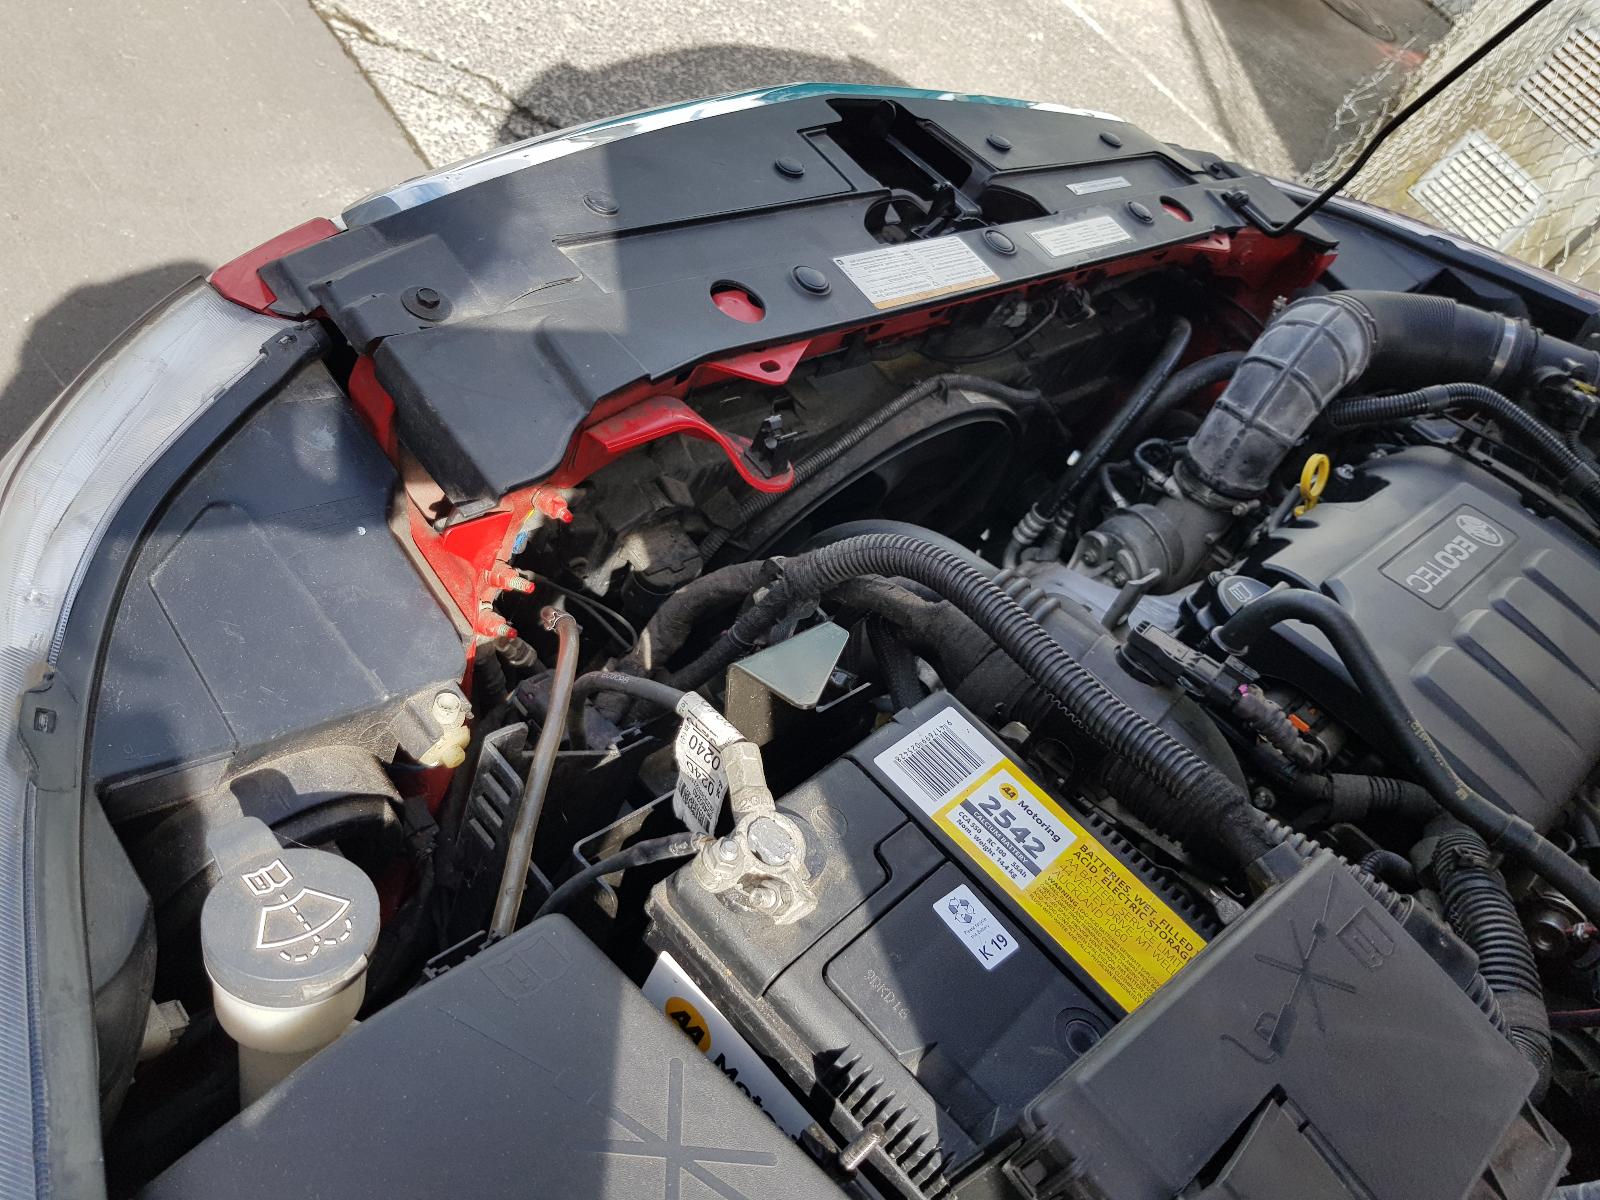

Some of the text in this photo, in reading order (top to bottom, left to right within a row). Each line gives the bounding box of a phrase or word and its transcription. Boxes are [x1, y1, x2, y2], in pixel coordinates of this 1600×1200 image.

[1405, 534, 1478, 594] ECOTEC
[686, 760, 713, 795] 0240
[687, 734, 721, 770] 0240
[972, 810, 1028, 863] CALCIUM BATTERY
[977, 794, 1047, 859] 2542
[1000, 784, 1062, 843] AA Motoring
[955, 819, 973, 835] Nom.
[972, 834, 996, 857] Weight
[1008, 868, 1018, 879] kg
[958, 811, 971, 824] CCA
[969, 822, 982, 834] 550
[994, 846, 1006, 857] 100
[1010, 861, 1027, 878] 55Ah
[1046, 876, 1078, 907] WARNING
[1051, 869, 1129, 942] AUCKLAND 1060
[1058, 863, 1073, 876] 44
[1072, 875, 1105, 908] VESTEY
[1105, 906, 1136, 938] DRIVE,
[1135, 935, 1152, 952] MT
[1064, 857, 1080, 871] AA
[1079, 869, 1119, 908] BATTERY
[1118, 907, 1157, 944] SERVICE
[1073, 851, 1192, 962] ACID, ELECTRIC STORAG
[978, 932, 1009, 961] K 19
[1159, 918, 1194, 952] FILLED
[669, 1010, 706, 1045] AA
